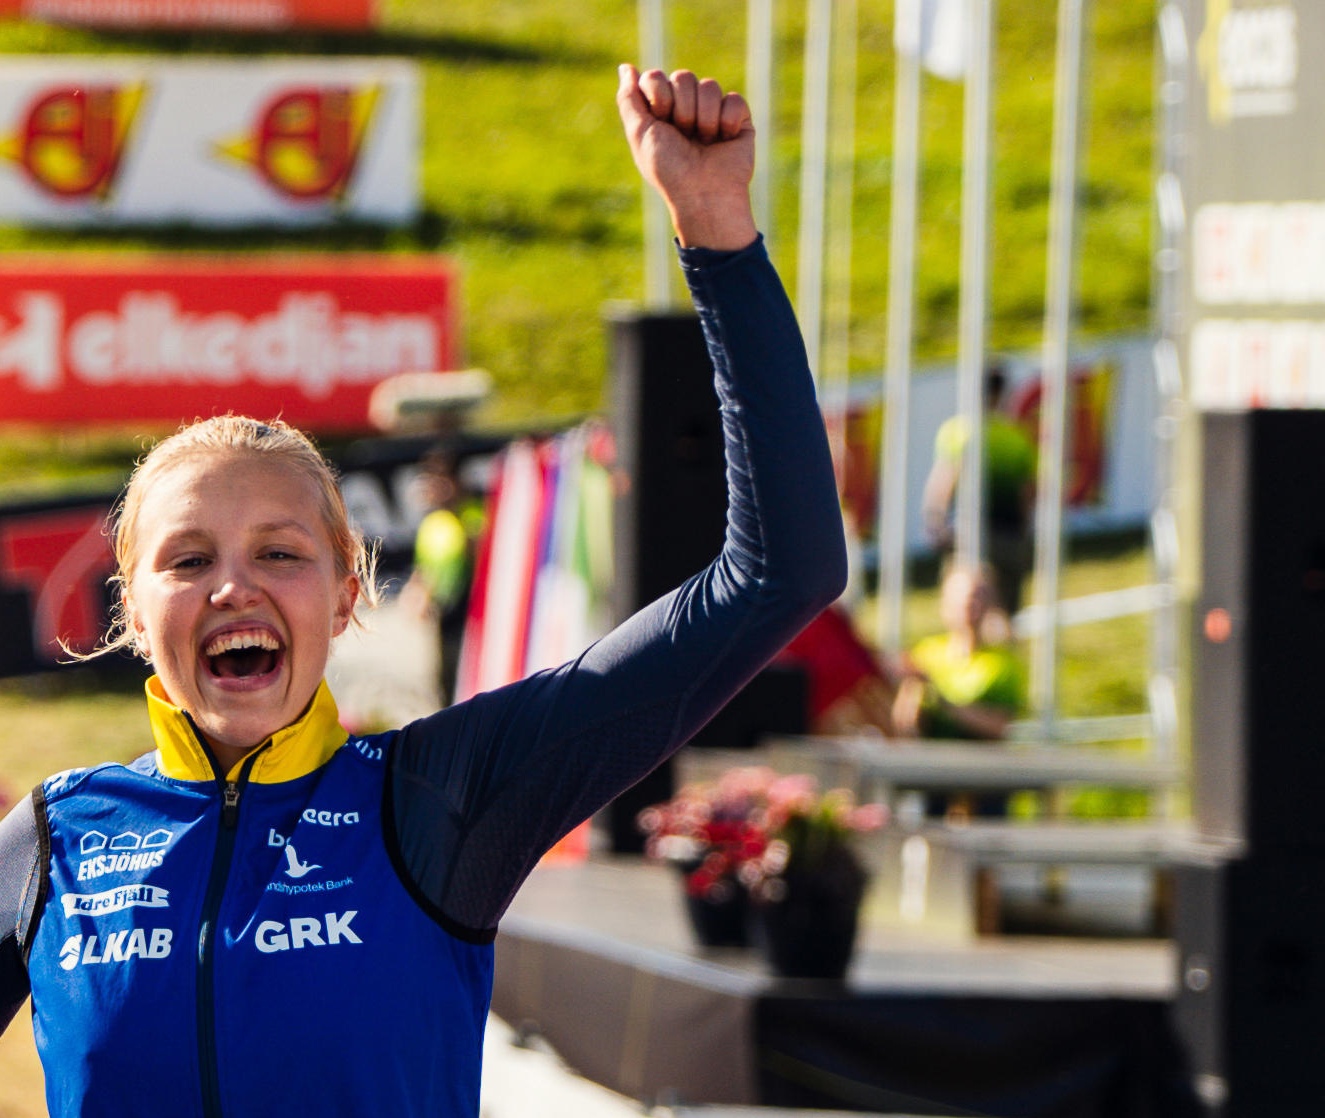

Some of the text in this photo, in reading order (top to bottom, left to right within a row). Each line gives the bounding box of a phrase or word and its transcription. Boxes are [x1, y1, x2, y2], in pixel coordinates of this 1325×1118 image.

[69, 291, 441, 398] elkedjan
[77, 849, 167, 881] EKSJÖHUS
[74, 887, 154, 911] Idre Fjäll
[326, 876, 354, 890] Bank
[81, 928, 174, 965] LKAB
[255, 910, 364, 954] GRK
